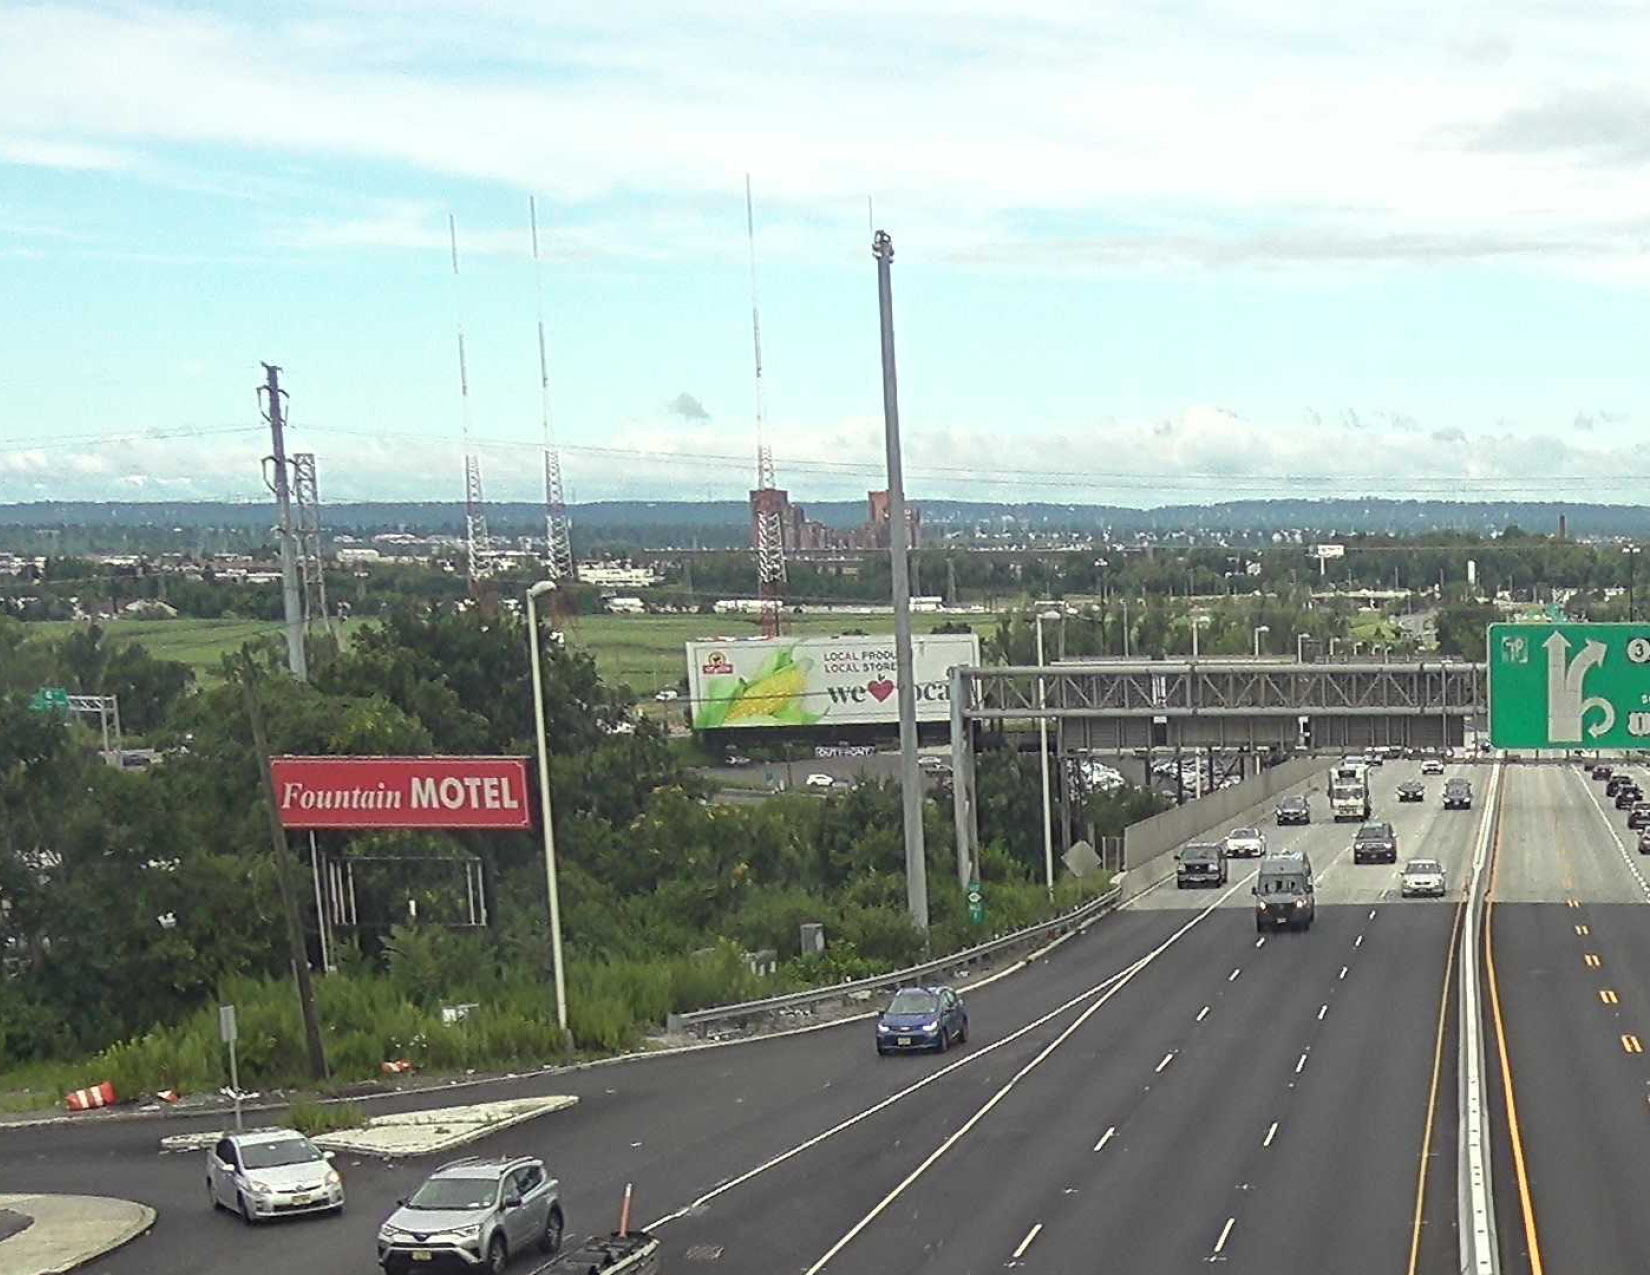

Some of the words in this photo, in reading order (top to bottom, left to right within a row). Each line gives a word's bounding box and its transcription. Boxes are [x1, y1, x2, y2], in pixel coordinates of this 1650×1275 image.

[824, 652, 858, 662] LOCAL
[1635, 643, 1644, 658] 3
[824, 663, 860, 674] LOCAL
[826, 684, 867, 704] we
[281, 782, 402, 809] Fountain
[410, 777, 519, 810] MOTEL
